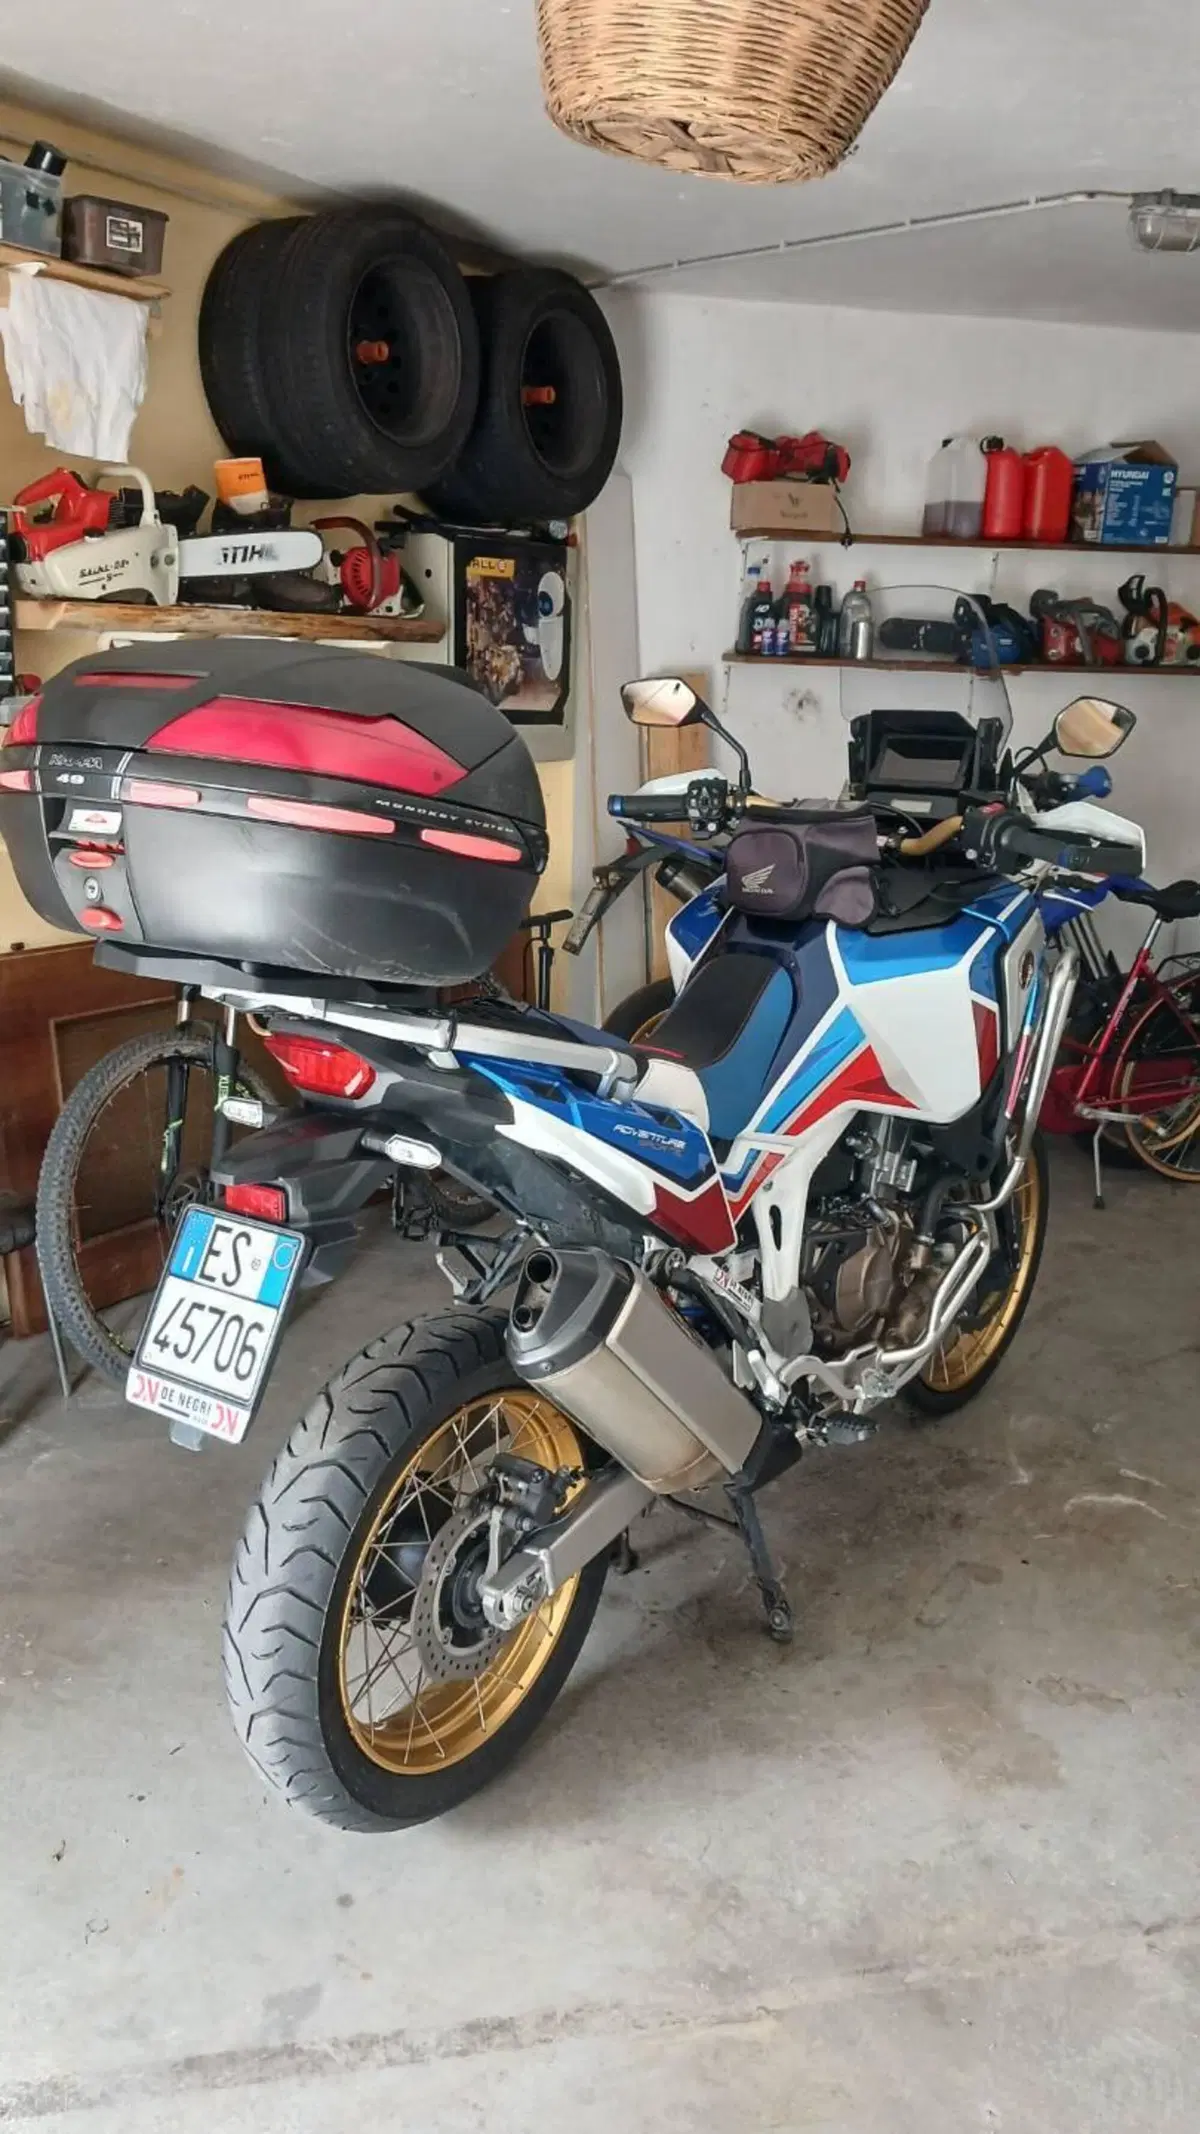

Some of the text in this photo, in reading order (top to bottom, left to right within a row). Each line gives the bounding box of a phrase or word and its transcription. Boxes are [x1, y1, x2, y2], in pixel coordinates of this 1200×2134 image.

[1110, 470, 1150, 480] HYUNDAI
[56, 773, 85, 785] 49
[375, 799, 459, 821] MONOKEY
[198, 1223, 253, 1287] ES
[152, 1297, 265, 1381] 45706
[160, 1386, 176, 1402] DE
[177, 1391, 213, 1415] NEGRI
